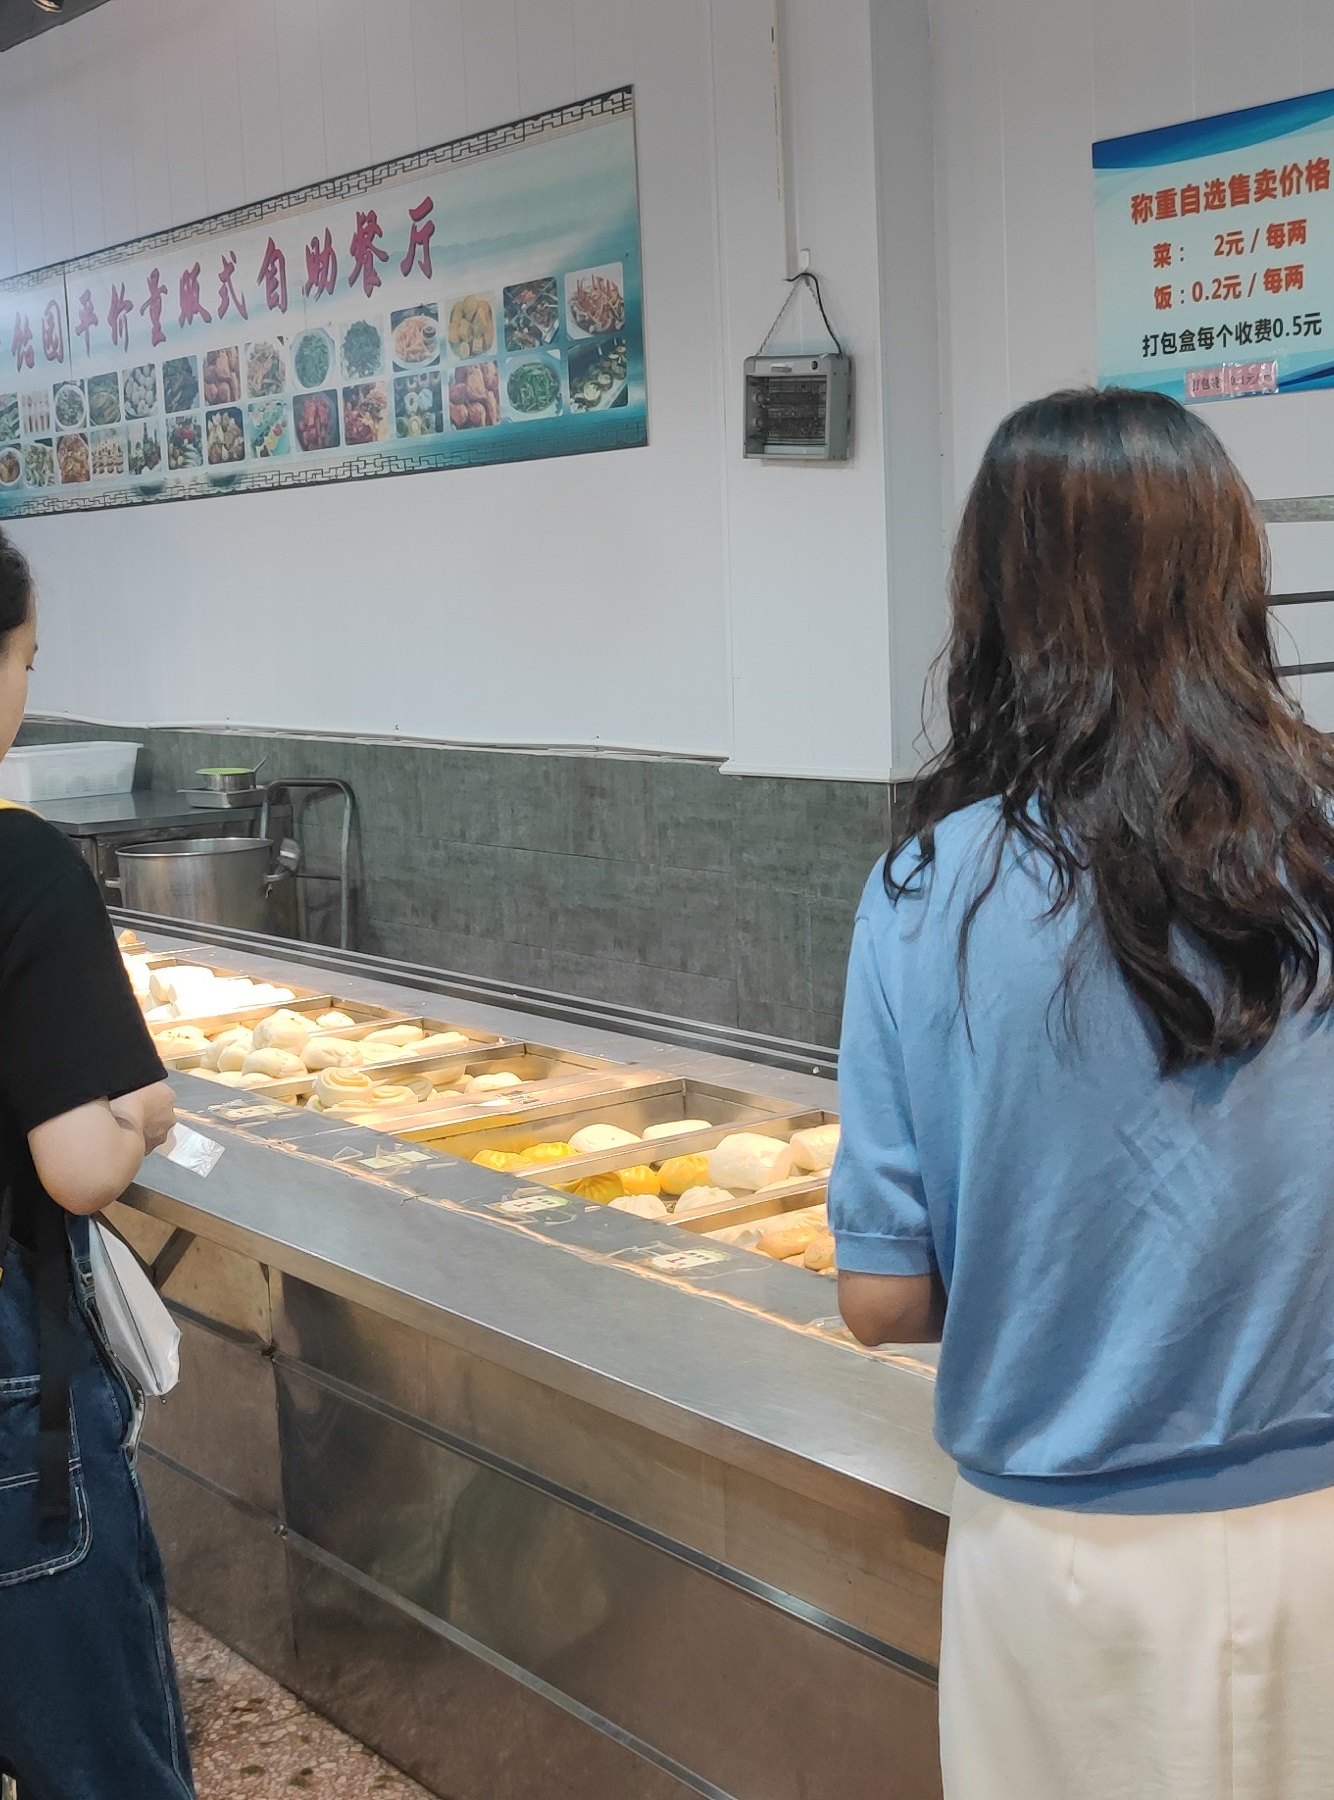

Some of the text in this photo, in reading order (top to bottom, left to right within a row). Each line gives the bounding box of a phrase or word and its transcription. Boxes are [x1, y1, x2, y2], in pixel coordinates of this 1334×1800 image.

[1131, 157, 1330, 224] 称重自选售卖价格
[1142, 312, 1322, 358] 打包盒每个收费0.5元
